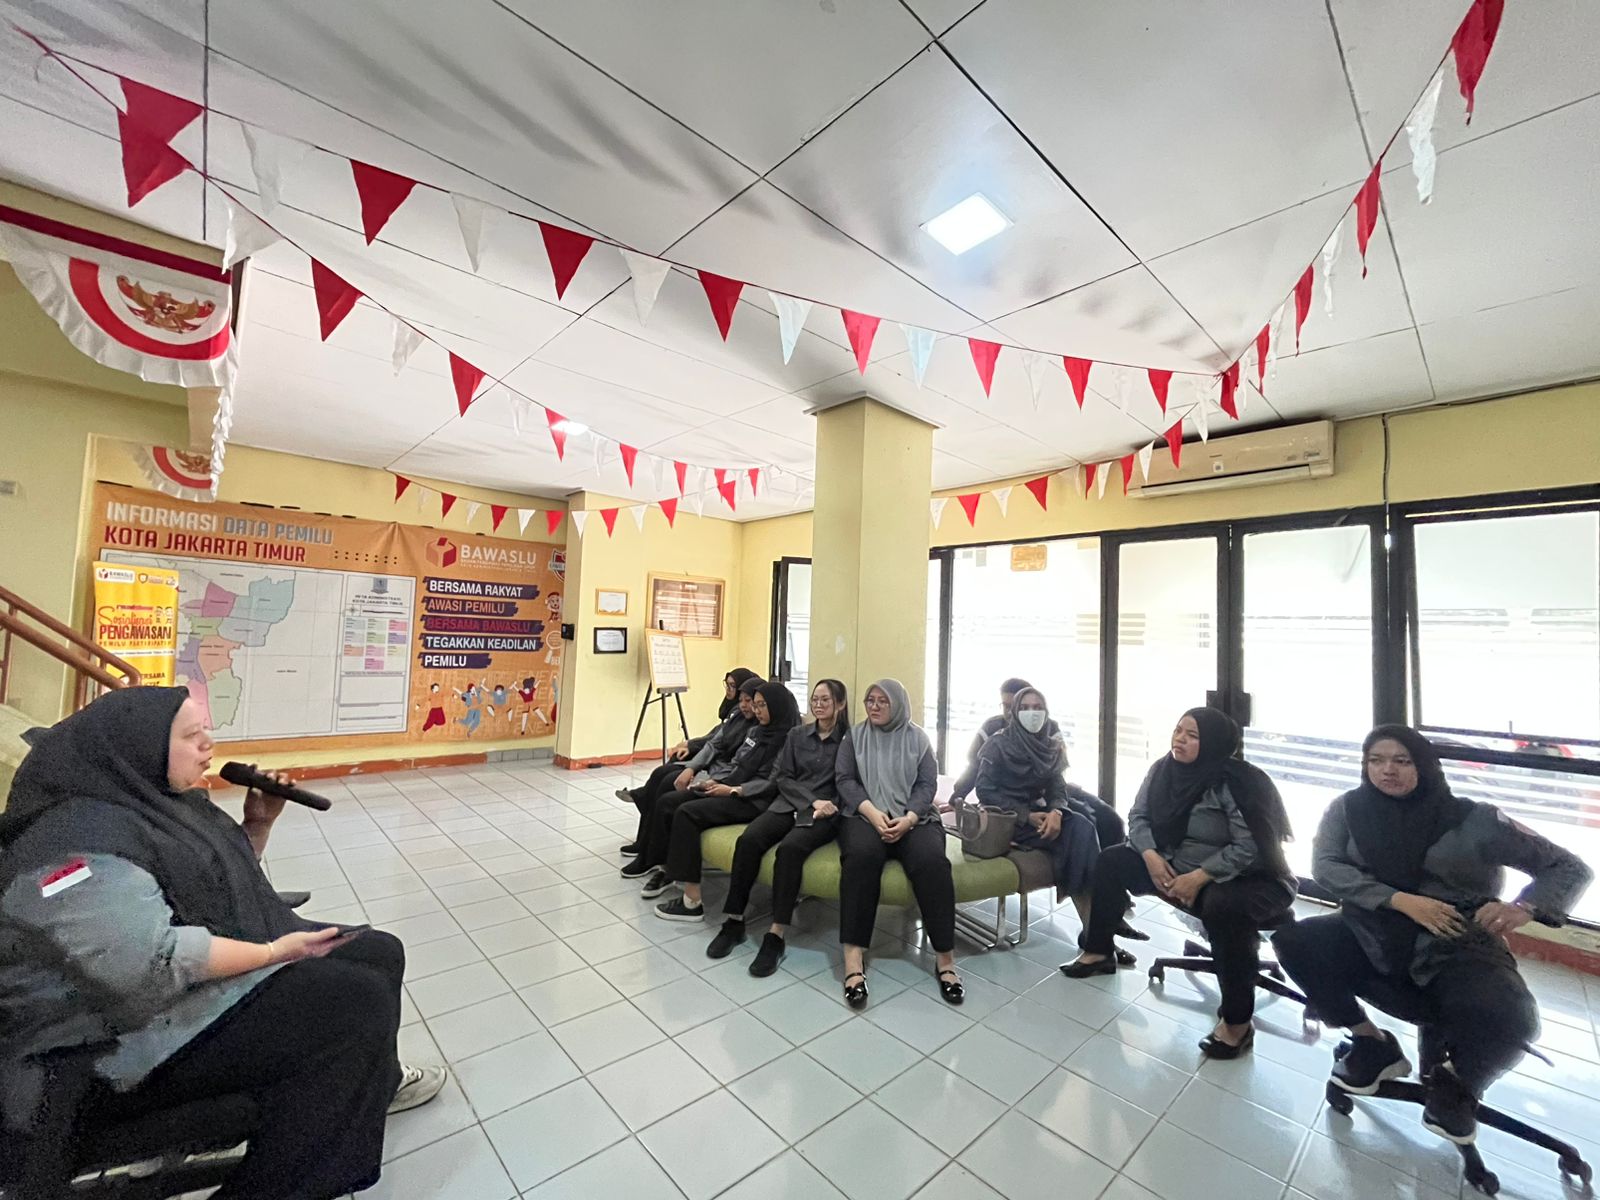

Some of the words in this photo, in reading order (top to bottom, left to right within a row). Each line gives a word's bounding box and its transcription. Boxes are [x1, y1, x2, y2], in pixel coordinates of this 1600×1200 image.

[106, 501, 219, 533] INFORMASI
[223, 516, 269, 536] DATA
[275, 523, 334, 545] PEMILU
[104, 525, 157, 548] KOTA
[163, 532, 248, 558] JAKARTA
[253, 541, 306, 563] TIMUR
[460, 544, 537, 565] BAWASLU
[429, 579, 482, 595] BERSAMA
[484, 584, 523, 598] RAKYAT
[427, 598, 462, 612] AWASI
[465, 601, 505, 614] PEMILU
[99, 625, 172, 640] PENGAWASAN
[426, 617, 481, 630] BERSAMA
[482, 620, 531, 633] BAWASLU
[425, 635, 485, 649] TEGAKKAN
[487, 638, 537, 650] KEADILAN
[424, 655, 467, 667] PEMILU
